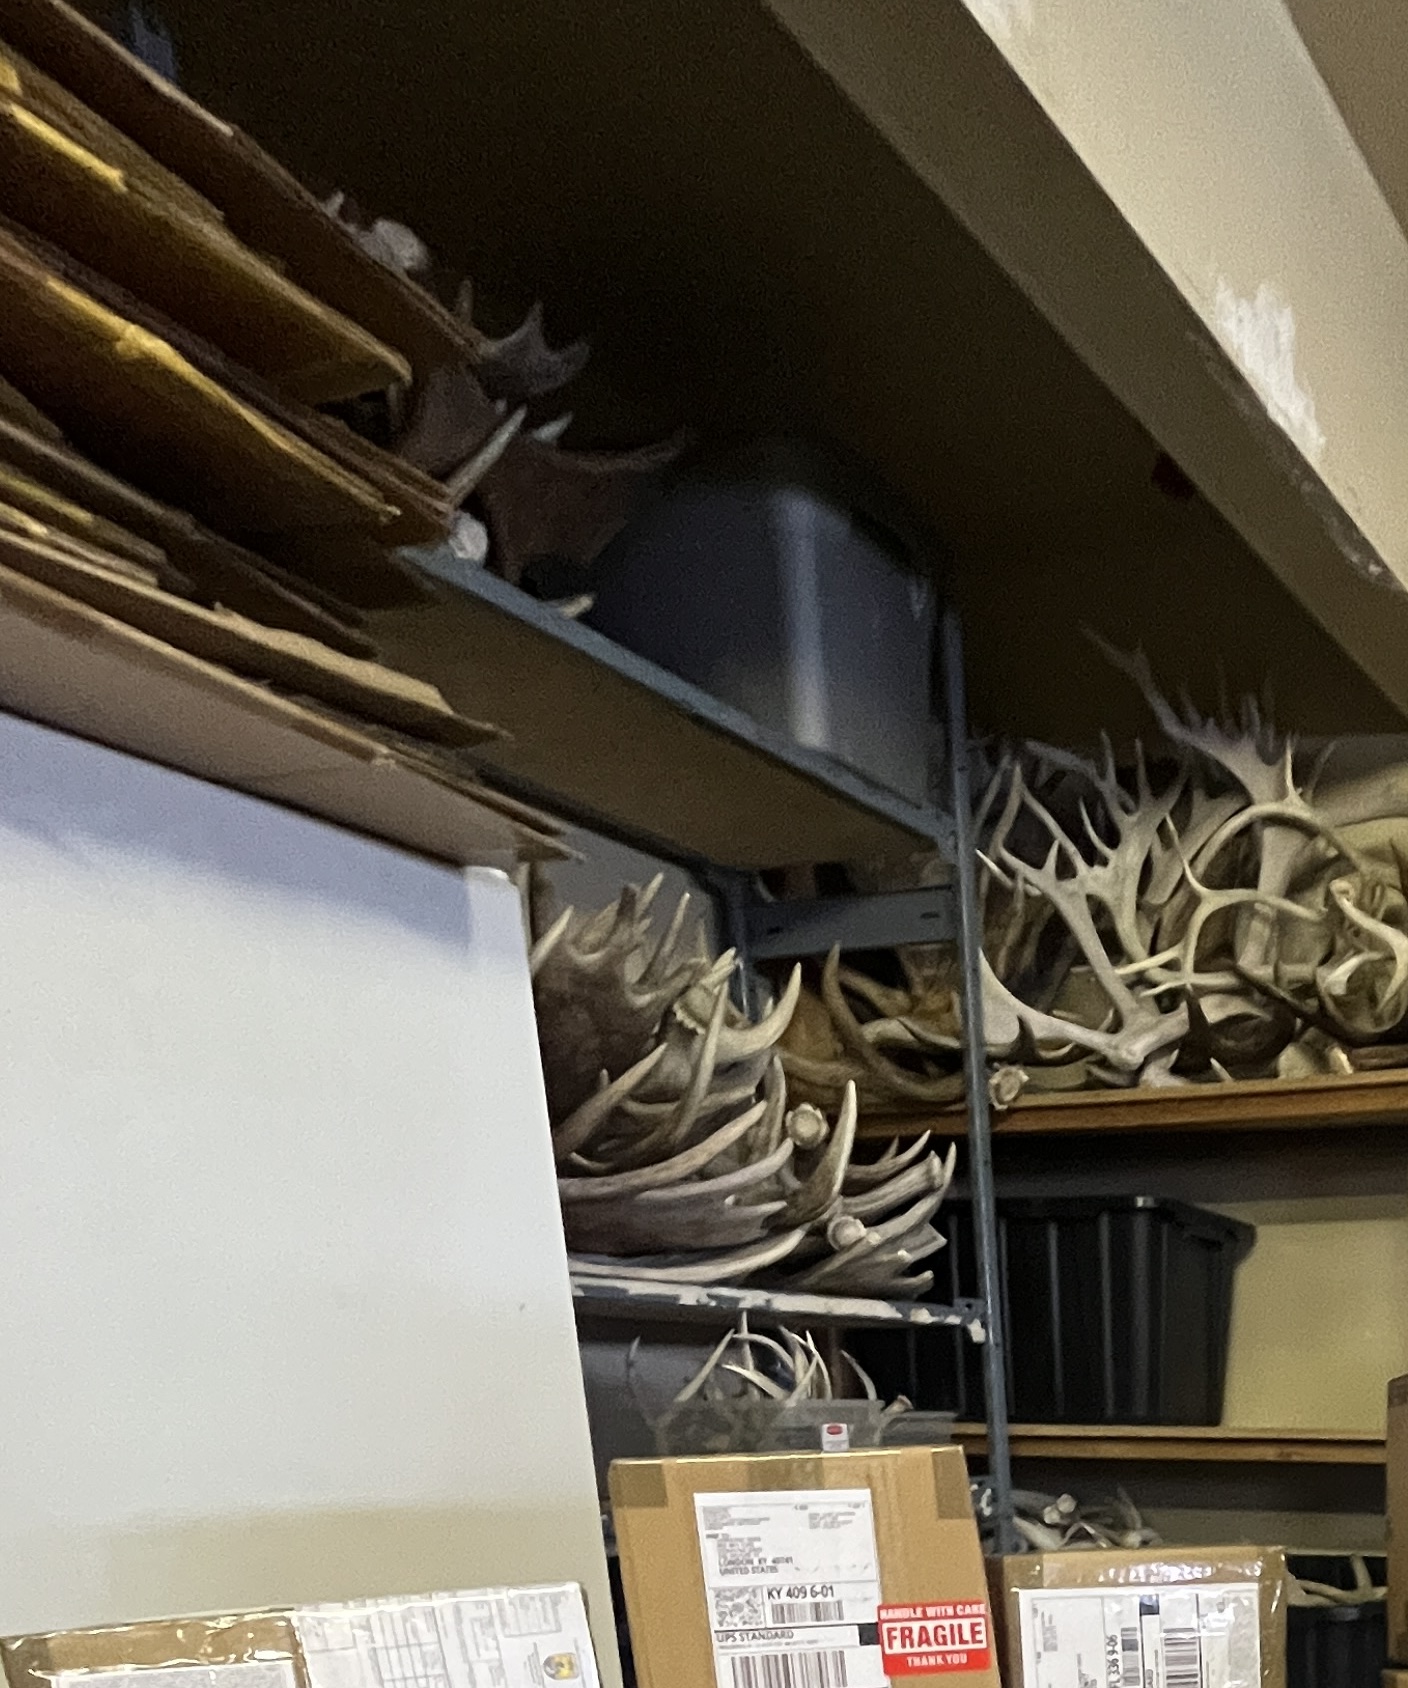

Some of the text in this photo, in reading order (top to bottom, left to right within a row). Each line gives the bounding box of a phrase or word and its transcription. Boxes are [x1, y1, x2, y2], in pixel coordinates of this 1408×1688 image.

[767, 1585, 835, 1600] KY 409 6-01
[925, 1605, 955, 1617] WITH
[956, 1603, 986, 1615] CARE
[716, 1630, 794, 1643] UPS STANDARD
[886, 1621, 984, 1650] FRAGILE
[906, 1653, 968, 1668] THANK YOU
[1107, 1657, 1120, 1675] 336
[1108, 1679, 1121, 1688] FL
